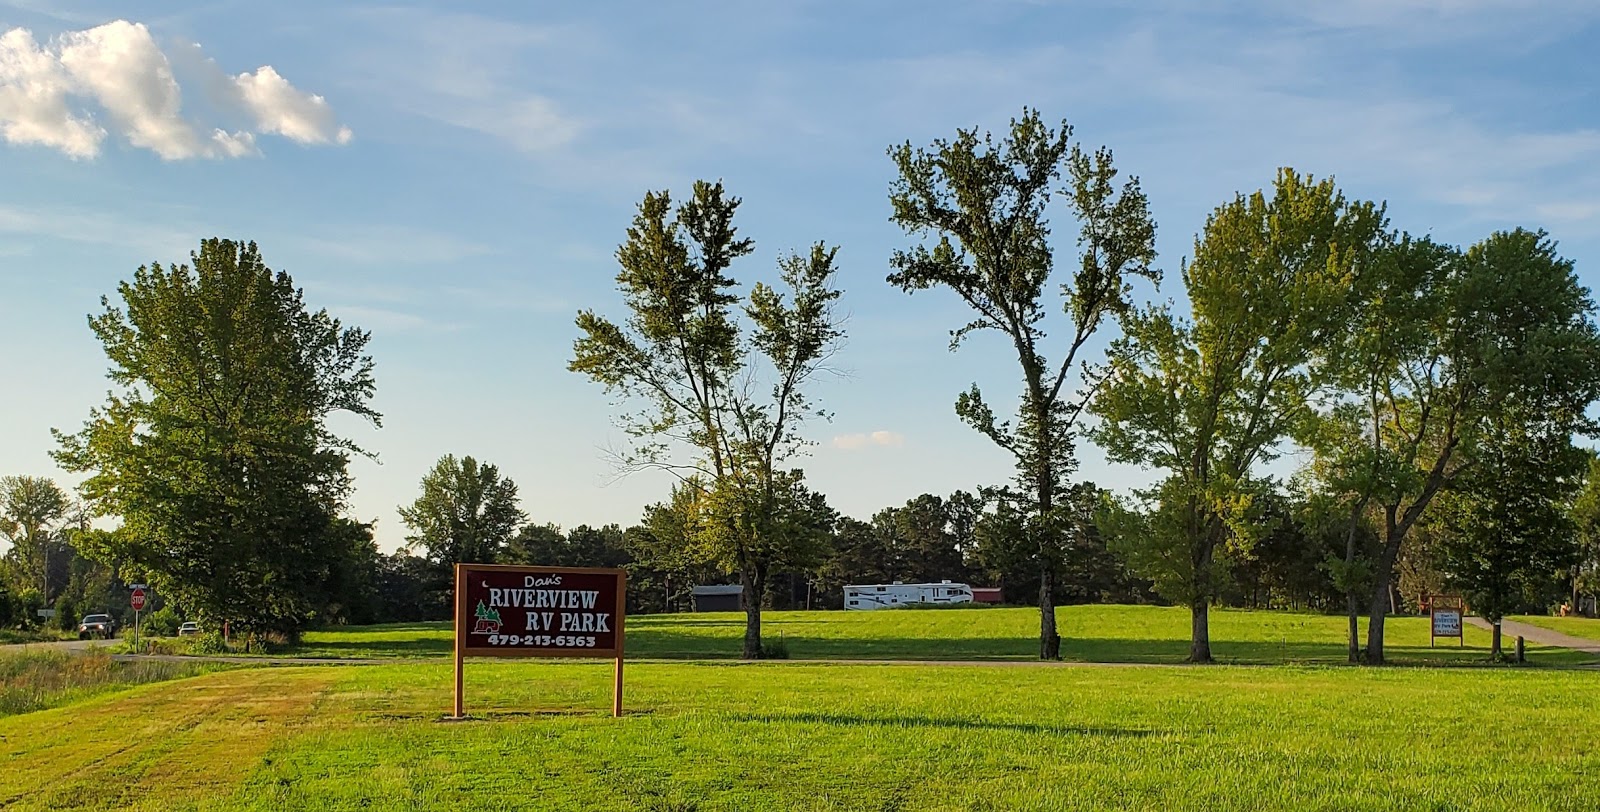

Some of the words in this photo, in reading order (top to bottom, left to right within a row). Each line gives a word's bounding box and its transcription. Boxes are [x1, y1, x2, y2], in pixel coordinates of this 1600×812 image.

[525, 574, 562, 587] Dan's
[132, 596, 145, 604] STOP
[490, 589, 599, 609] RIVERVIEW
[526, 612, 554, 630] RV
[560, 613, 611, 632] PARK
